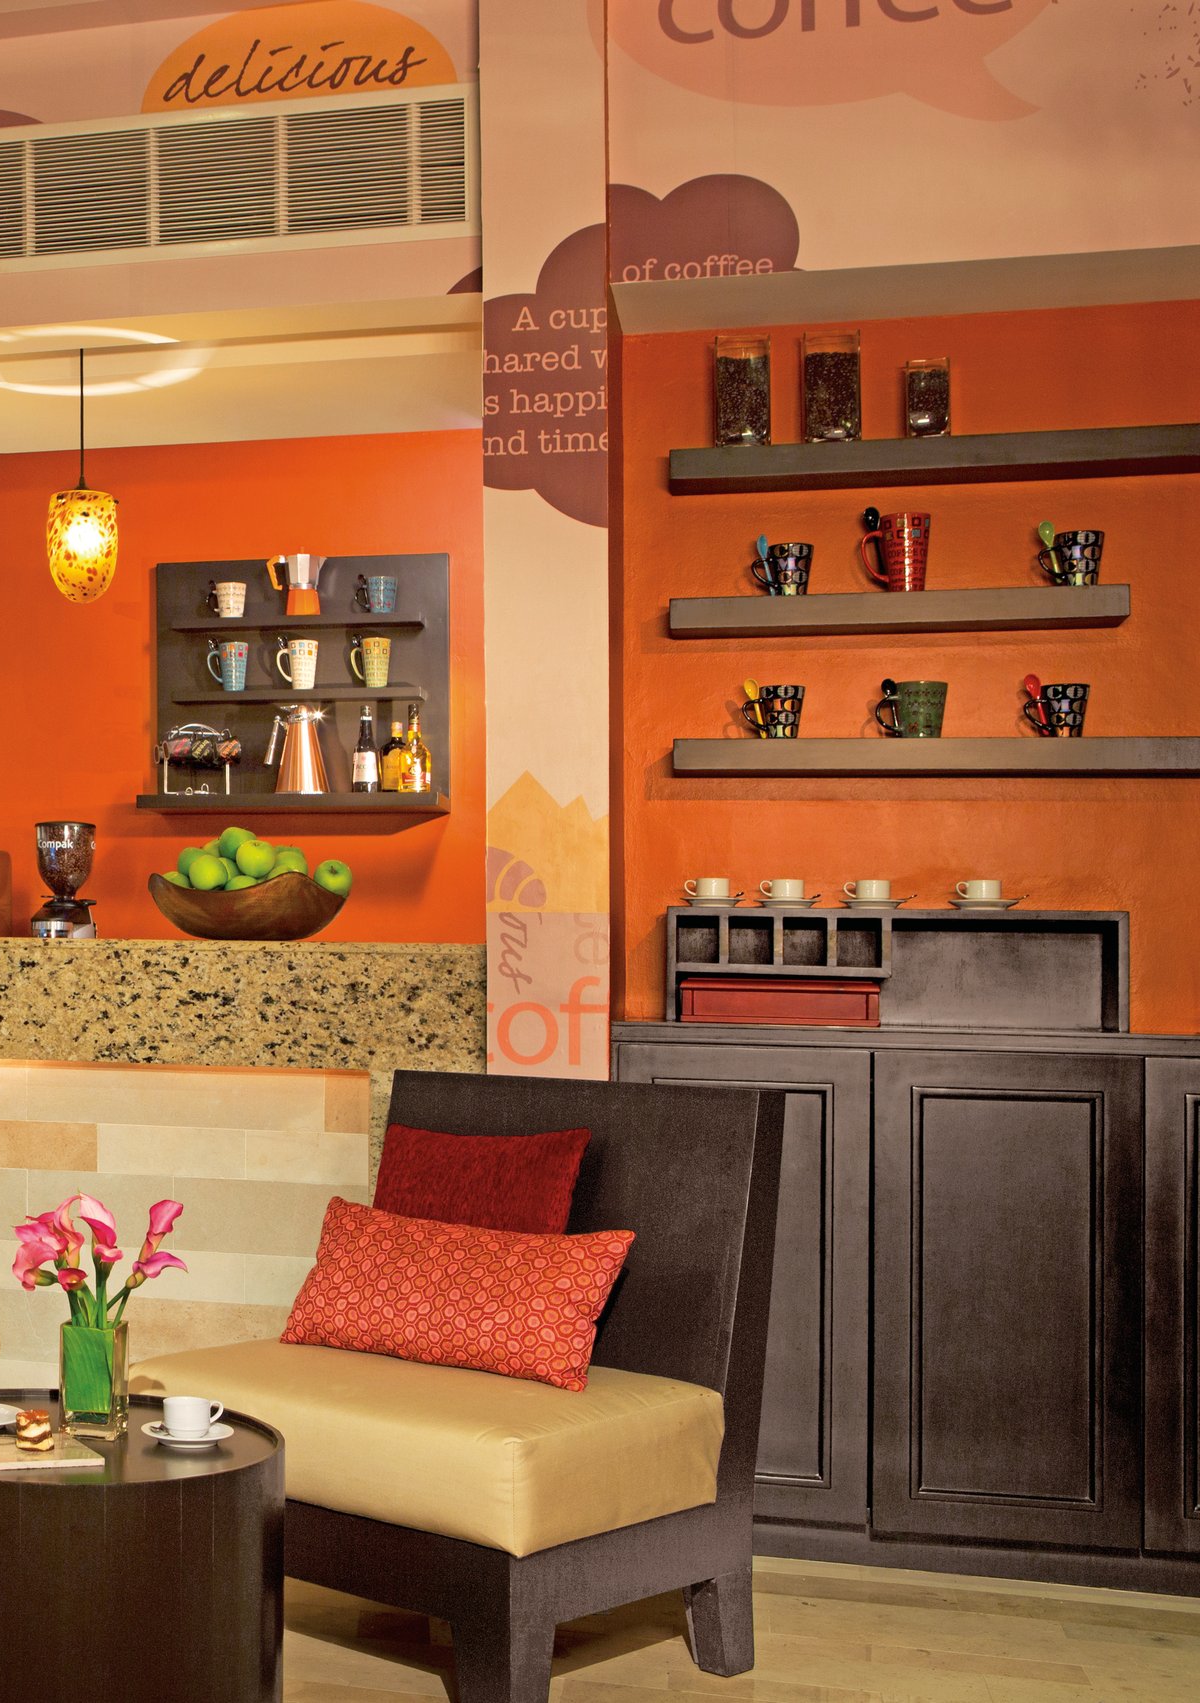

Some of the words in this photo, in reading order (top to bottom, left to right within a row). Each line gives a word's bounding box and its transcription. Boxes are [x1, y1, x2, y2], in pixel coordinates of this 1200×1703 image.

[162, 40, 428, 102] delicious
[623, 258, 658, 283] of
[512, 306, 540, 332] A
[549, 307, 608, 334] cup
[38, 839, 74, 851] Compak
